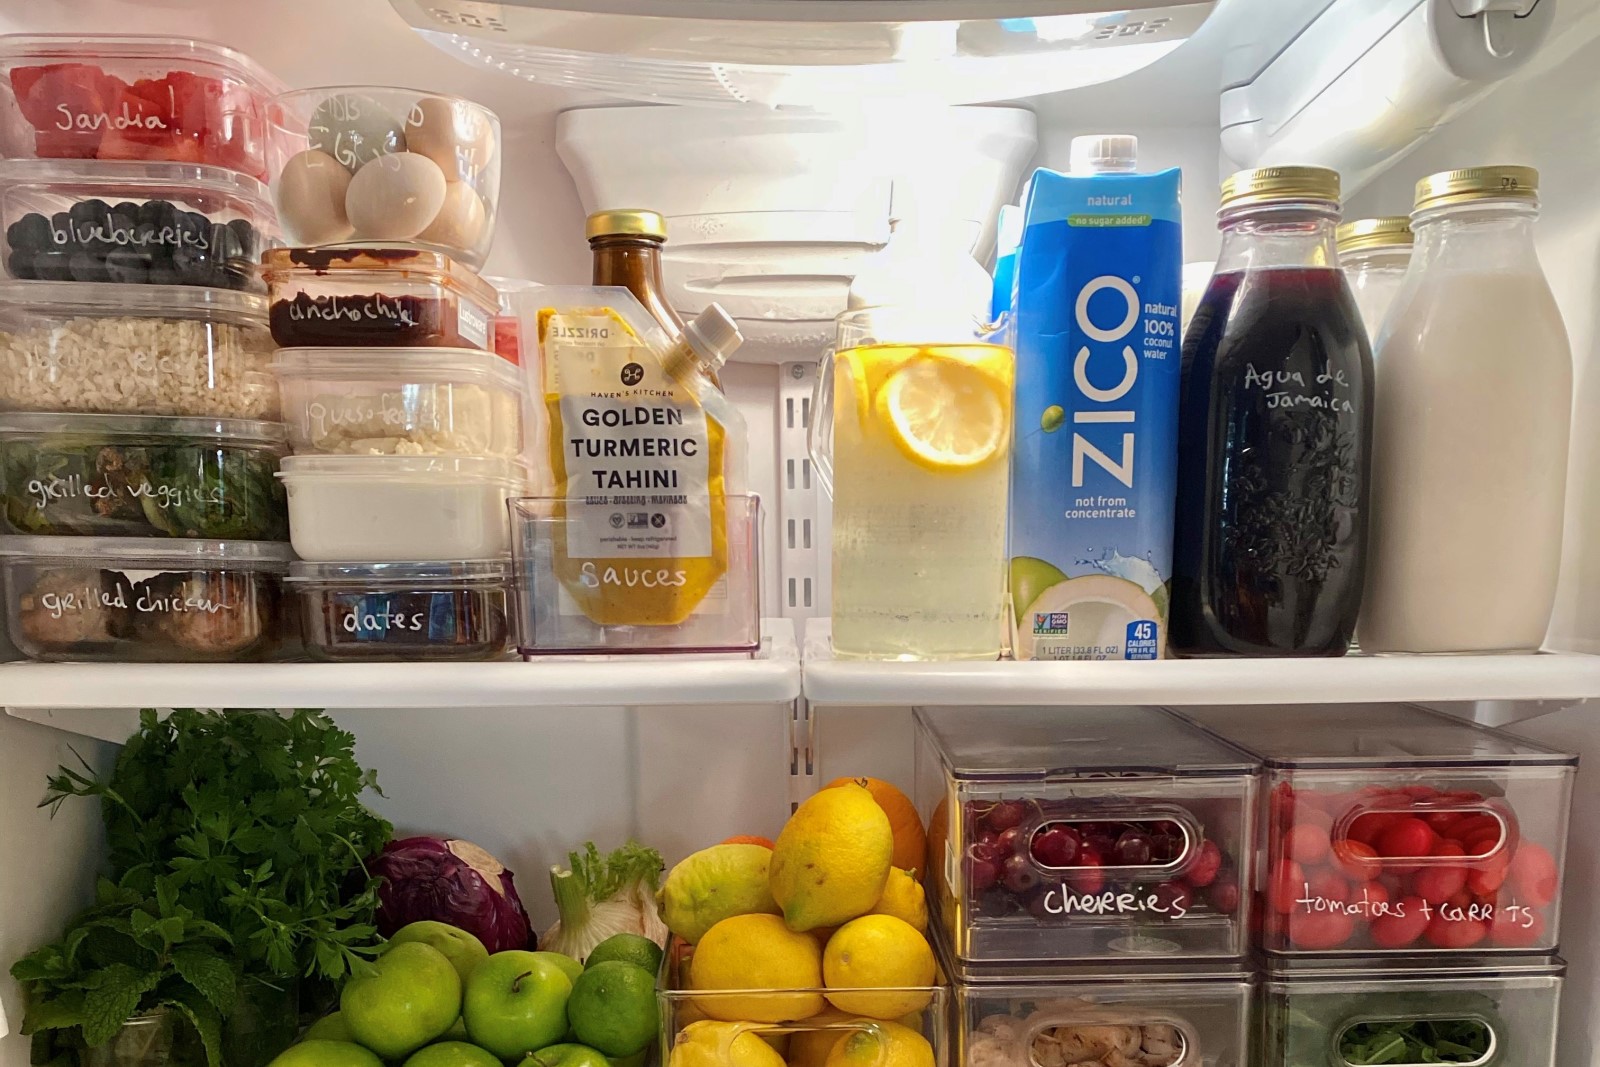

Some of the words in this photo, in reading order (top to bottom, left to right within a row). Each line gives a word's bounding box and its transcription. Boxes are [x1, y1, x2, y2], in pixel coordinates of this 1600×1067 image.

[1087, 194, 1132, 206] natural
[1076, 217, 1087, 225] no
[1088, 217, 1113, 227] sugar
[1144, 303, 1177, 317] natural
[1143, 319, 1175, 336] 100%
[1143, 338, 1173, 348] coconut
[1143, 349, 1168, 360] water
[1072, 275, 1140, 489] ZICO
[1244, 362, 1305, 389] Agua
[1316, 359, 1349, 387] de
[590, 390, 630, 399] HAVEN'S
[633, 389, 674, 397] KITCHEN
[1266, 390, 1354, 413] Jamaica
[582, 406, 683, 427] GOLDEN
[571, 438, 697, 457] TURMERIC
[592, 470, 678, 488] TAHINI
[127, 482, 222, 508] veggies
[1075, 496, 1095, 507] not
[1098, 495, 1127, 507] from
[1065, 507, 1136, 519] concentrate
[581, 562, 687, 587] Sauces
[136, 582, 232, 613] chicken
[343, 601, 424, 632] dates
[1134, 623, 1152, 640] 45
[1048, 646, 1072, 654] LITER
[1093, 646, 1103, 654] FL
[1128, 639, 1156, 647] CALORIES
